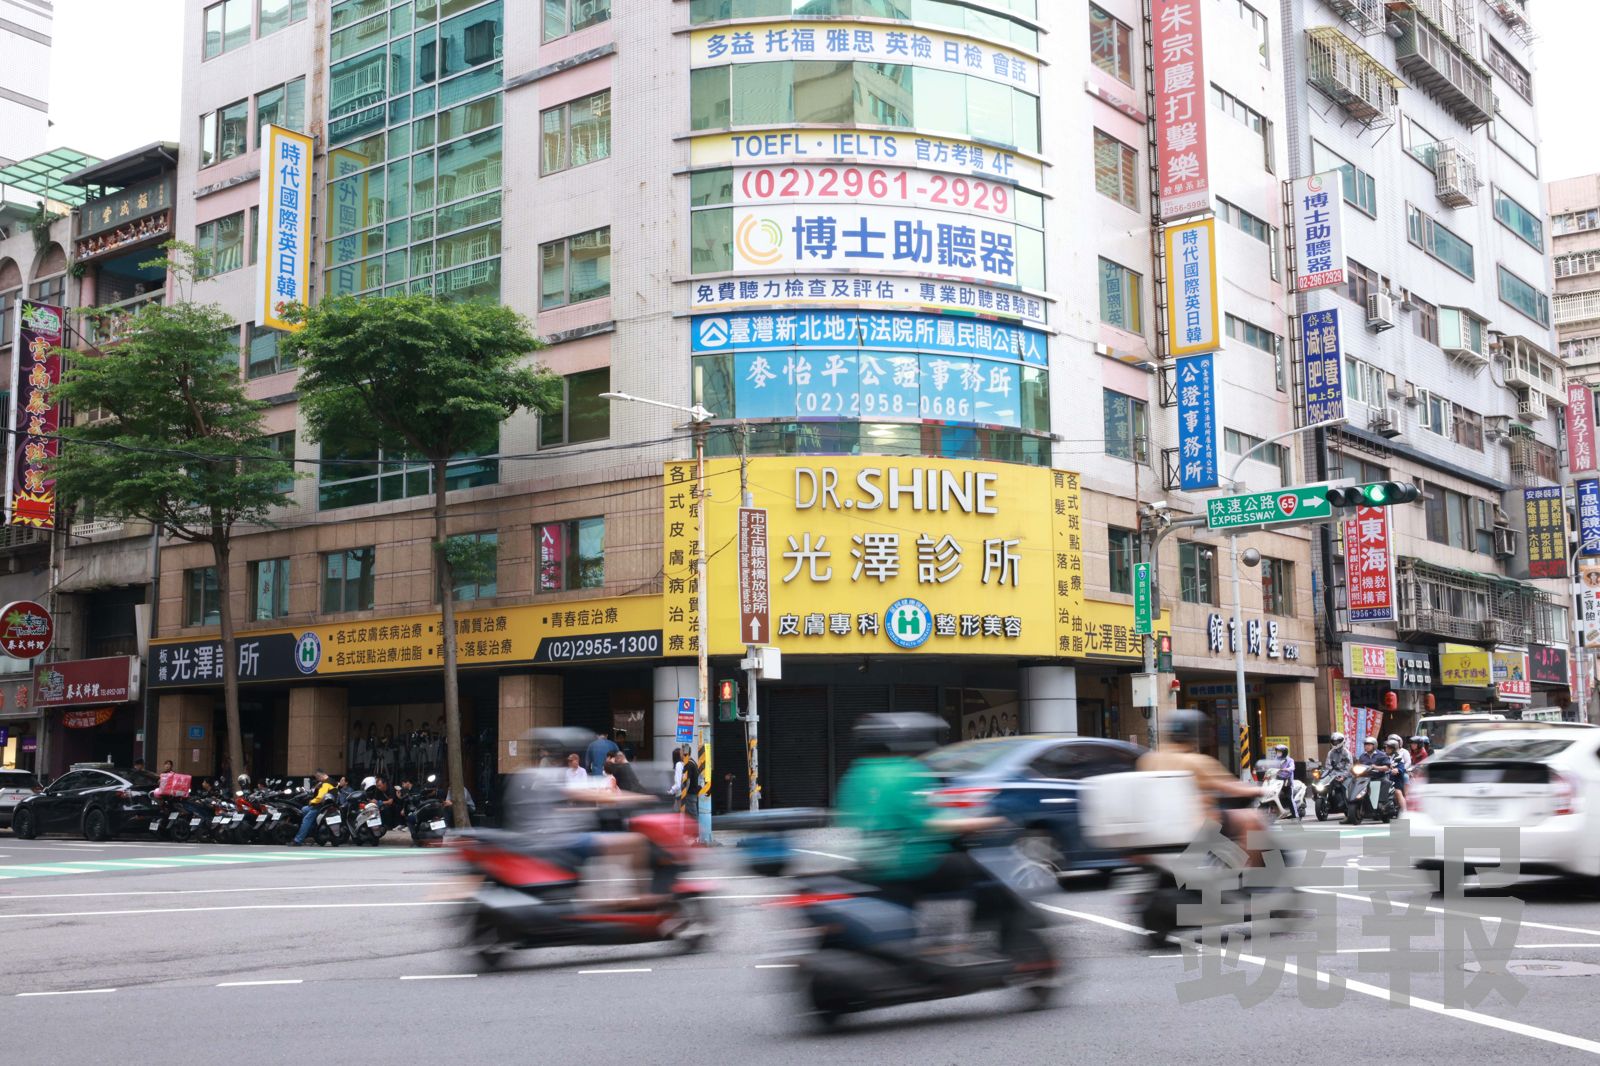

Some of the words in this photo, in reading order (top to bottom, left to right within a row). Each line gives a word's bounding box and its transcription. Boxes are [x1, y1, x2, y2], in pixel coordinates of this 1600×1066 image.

[707, 31, 754, 58] 多益
[766, 28, 815, 53] 托福
[826, 29, 875, 53] 雅思
[886, 31, 932, 59] 英檢
[943, 41, 983, 70] 日檢
[992, 52, 1027, 83] 會話
[1161, 4, 1199, 184] 朱宗慶打擊樂
[731, 135, 807, 157] TOEFL
[833, 134, 897, 158] IELTS
[915, 139, 984, 169] 官方考場
[992, 151, 1014, 175] 4F
[741, 167, 1009, 215] (02)2961-2929
[276, 142, 300, 299] 時代國際英日韓
[1303, 192, 1332, 273] 博士助聽器
[792, 215, 1016, 276] 博士助聽器
[1182, 229, 1202, 344] 時代國際英日韓
[1299, 272, 1342, 289] 02-29612929
[729, 316, 1041, 360] 臺灣新北地方法院所屬民間公證人
[1306, 328, 1322, 388] 減肥
[796, 392, 969, 417] (02)2958-0686
[1181, 362, 1204, 483] 公證事務所
[1210, 495, 1275, 516] 快速公路
[1281, 497, 1295, 508] 65
[1211, 510, 1276, 526] EXPRESSWAY
[668, 465, 685, 652] 各式皮膚病治療
[751, 512, 767, 614] 市定古蹟板橋放送所
[782, 532, 1022, 586] 光澤診所
[1362, 576, 1375, 604] 機構
[1374, 575, 1387, 603] 教育
[336, 623, 422, 645] 各式皮膚疾病治療
[551, 607, 618, 628] 青春痘治療
[778, 613, 880, 637] 皮膚專科
[934, 613, 1022, 638] 整形美容
[158, 649, 168, 681] 板橋
[336, 646, 422, 666] 各式斑點治療/抽脂
[548, 635, 657, 661] (02)2955-1300
